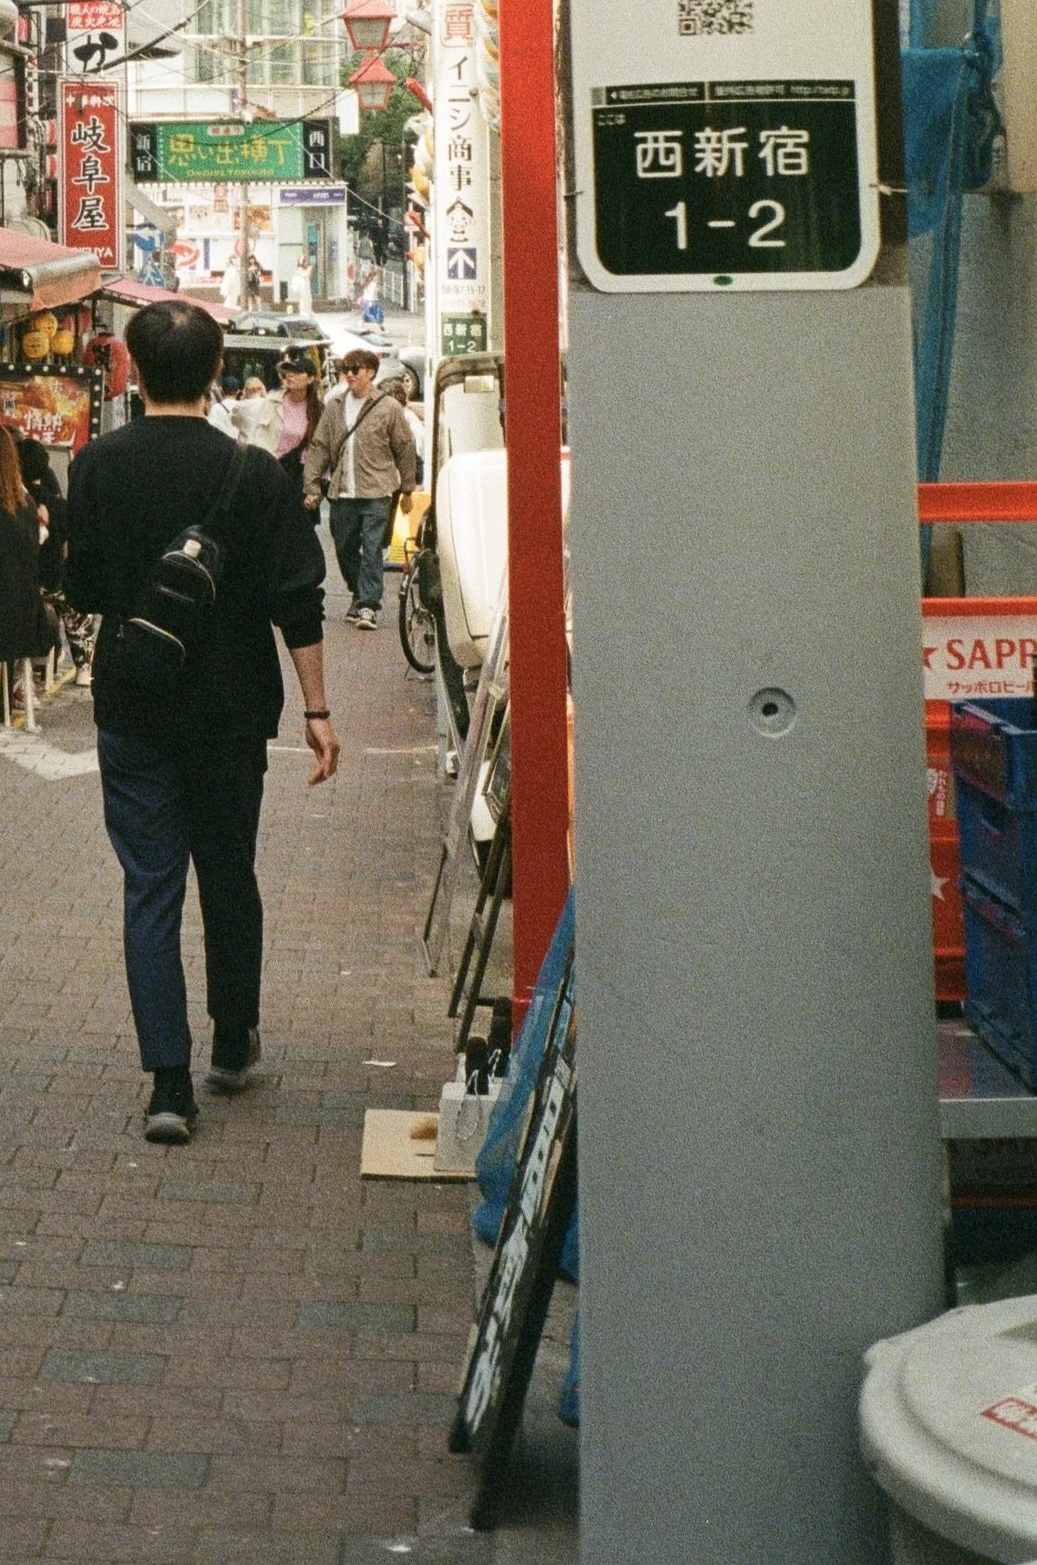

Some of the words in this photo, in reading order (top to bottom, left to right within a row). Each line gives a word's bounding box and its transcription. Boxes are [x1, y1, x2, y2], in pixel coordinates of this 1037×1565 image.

[167, 132, 292, 167] 思い出横丁
[447, 56, 474, 192] イニシ商事
[633, 124, 810, 179] 西新宿
[71, 115, 111, 231] 岐阜屋
[664, 198, 787, 251] 1-2
